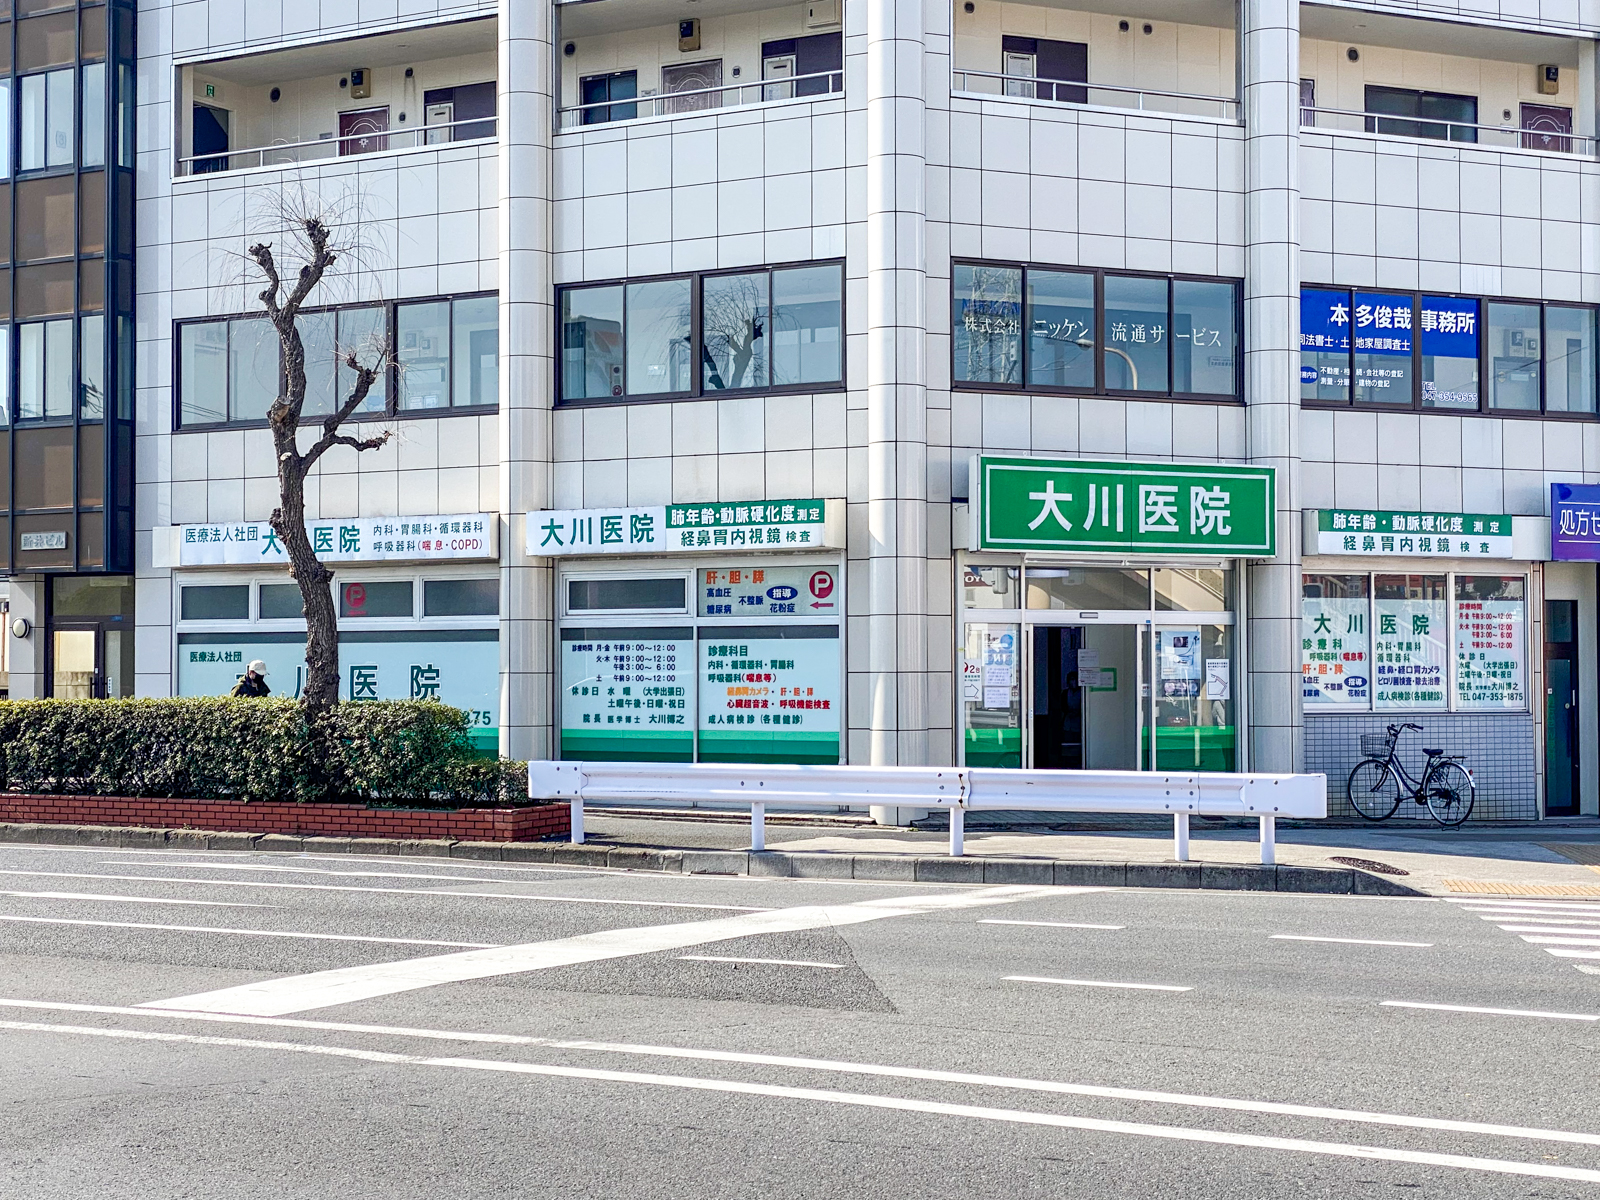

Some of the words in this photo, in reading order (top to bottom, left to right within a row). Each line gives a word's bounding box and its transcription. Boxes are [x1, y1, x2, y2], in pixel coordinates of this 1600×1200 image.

[965, 316, 1020, 335] 株式会社
[1033, 318, 1089, 338] ニッケン
[1111, 321, 1222, 347] 流通サービス
[1422, 381, 1437, 390] TEL
[1027, 480, 1232, 535] 大川医院
[671, 505, 795, 526] 肺年齢・動脈硬化度
[797, 508, 820, 521] 測定
[373, 521, 483, 536] 内科・胃腸科・循環器科
[1333, 513, 1463, 533] 肺年齢・動脈硬化度
[1473, 521, 1500, 533] 測定
[540, 513, 655, 547] 大川医院
[185, 526, 258, 543] 医療法人社団
[261, 525, 361, 555] 大医院
[680, 527, 781, 547] 経鼻胃内視鏡
[785, 530, 811, 543] 検査
[1343, 535, 1450, 552] 経鼻胃内視鏡
[1460, 541, 1490, 553] 検査
[706, 588, 732, 598] 高血圧
[772, 588, 792, 598] 指導
[738, 595, 764, 606] 不整脈
[706, 604, 732, 615] 糖尿病
[769, 603, 796, 613] 花粉症
[1313, 612, 1430, 636] 大川医院
[189, 651, 242, 663] 医療法人社団
[708, 645, 748, 657] 診療科目
[571, 686, 599, 696] 休診日
[1459, 692, 1471, 700] TEL
[1472, 692, 1524, 701] 047-353-1875
